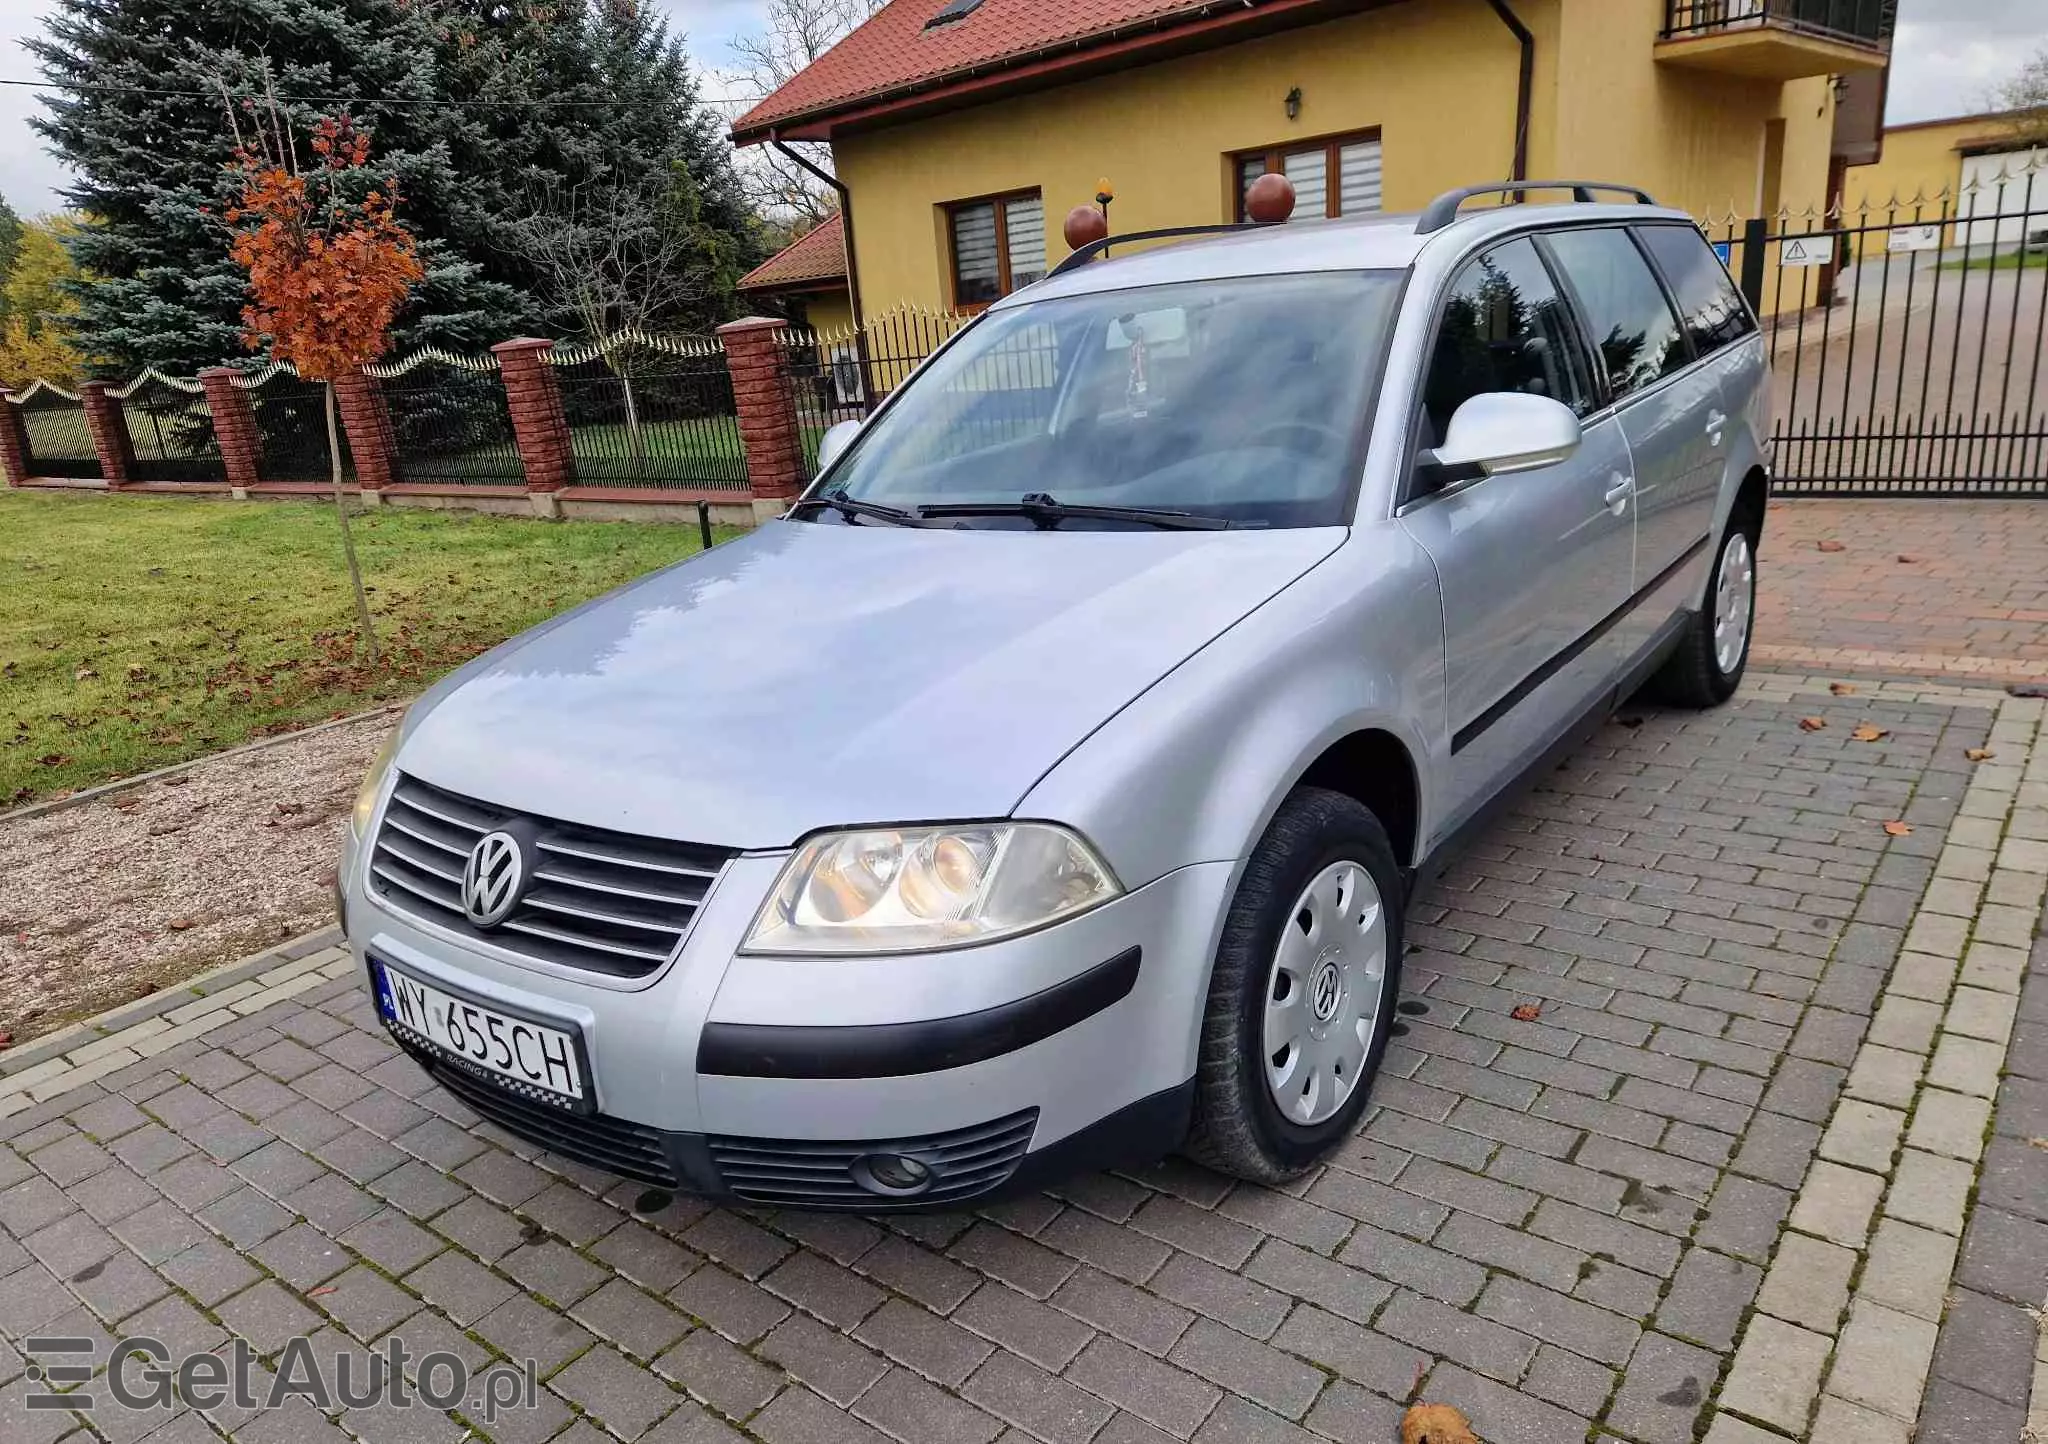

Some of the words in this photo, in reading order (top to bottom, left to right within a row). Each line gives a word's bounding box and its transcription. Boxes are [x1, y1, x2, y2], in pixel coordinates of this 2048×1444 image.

[462, 831, 522, 925] VW
[390, 971, 431, 1036] WY
[447, 1001, 573, 1093] 655CH
